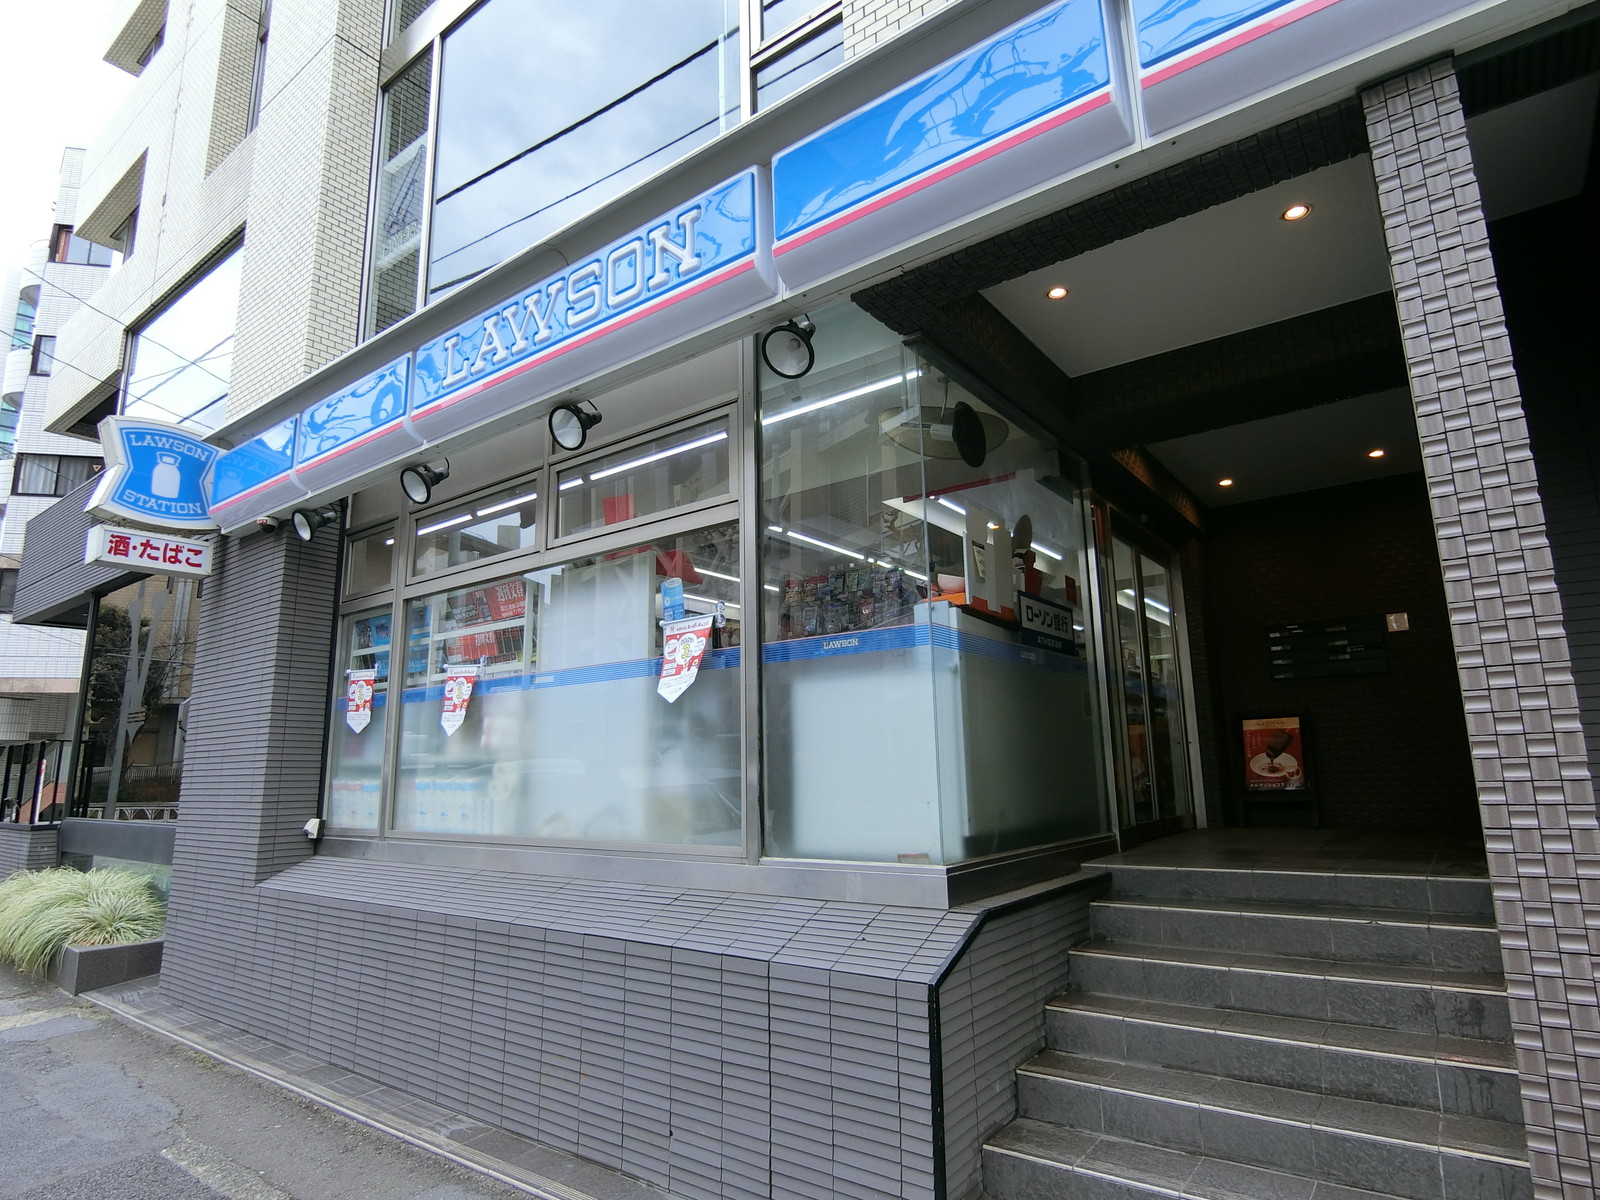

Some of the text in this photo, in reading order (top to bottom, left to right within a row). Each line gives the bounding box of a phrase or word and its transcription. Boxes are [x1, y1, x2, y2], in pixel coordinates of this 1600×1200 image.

[442, 205, 702, 388] LAWSON
[129, 434, 209, 462] LAWSON
[123, 489, 203, 514] STATION
[1026, 605, 1068, 633] ローソン銀行
[823, 638, 858, 650] LAWSON
